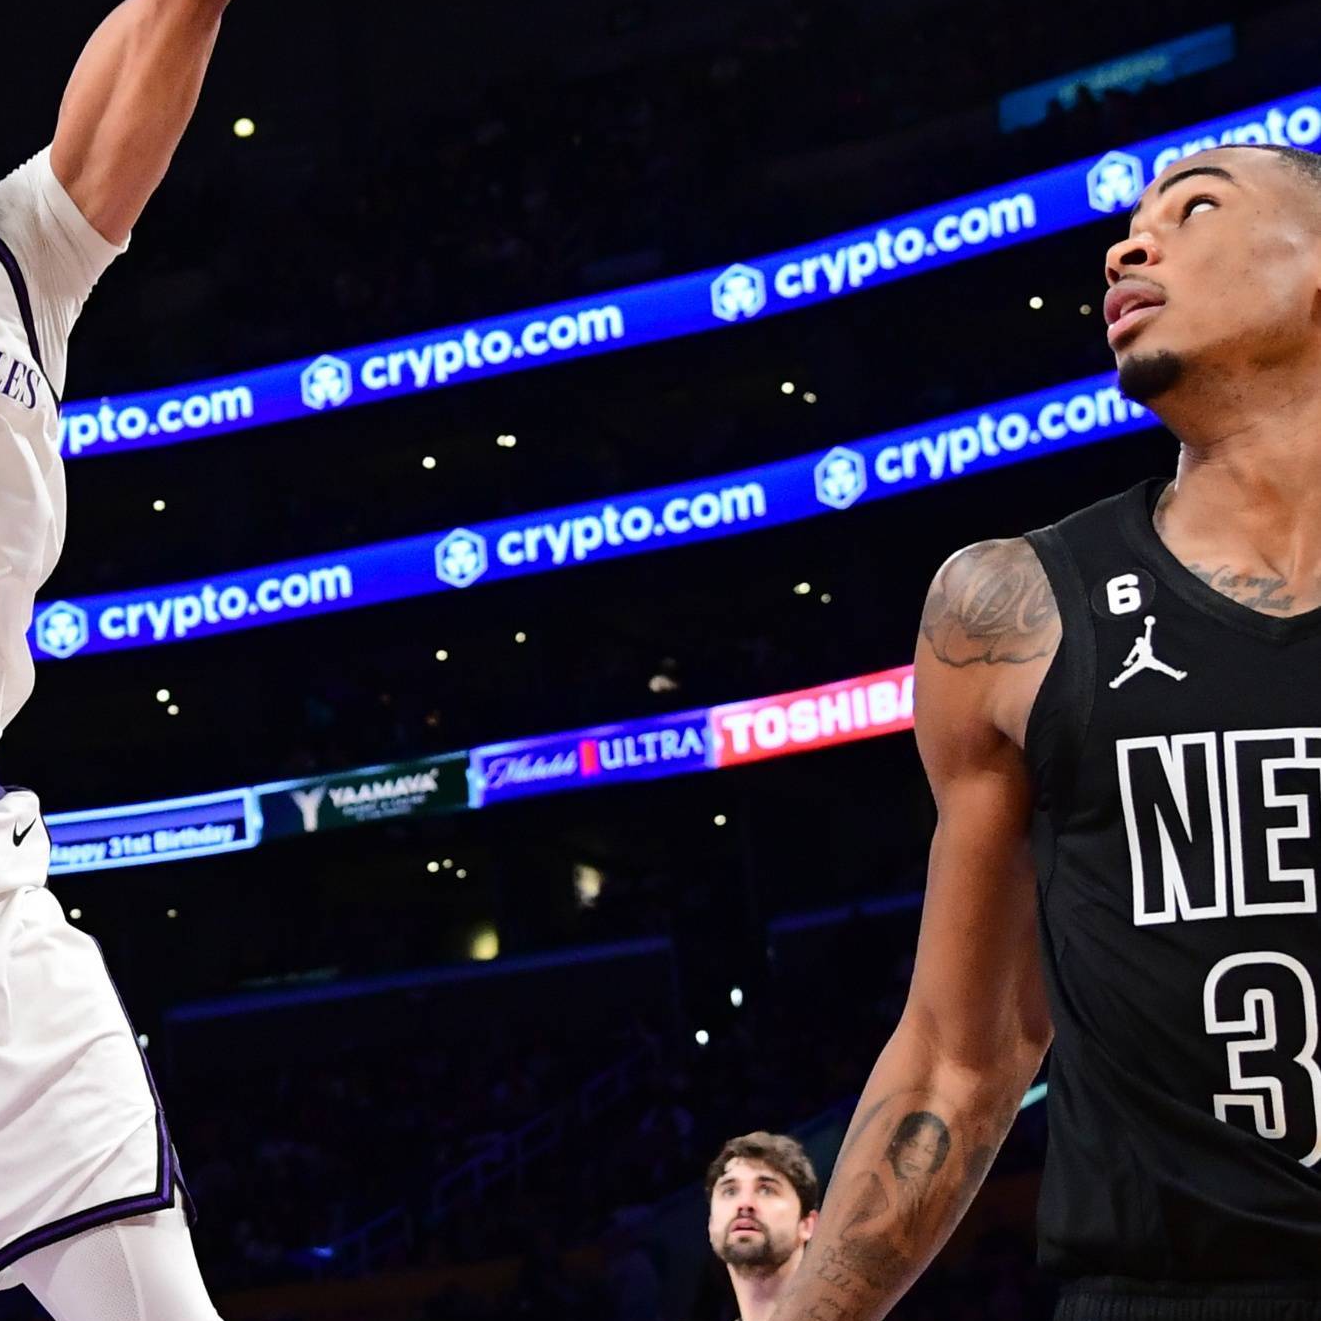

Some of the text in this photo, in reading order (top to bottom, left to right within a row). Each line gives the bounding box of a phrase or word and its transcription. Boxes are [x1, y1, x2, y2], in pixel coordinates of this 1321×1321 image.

[774, 192, 1036, 299] crypto.com
[360, 303, 624, 390] crypto.com
[496, 482, 766, 565] crypto.com
[98, 564, 353, 640] crypto.com
[1106, 573, 1142, 615] 6
[599, 728, 703, 770] ULTRA
[1116, 727, 1321, 926] NE
[1203, 950, 1321, 1169] 3
